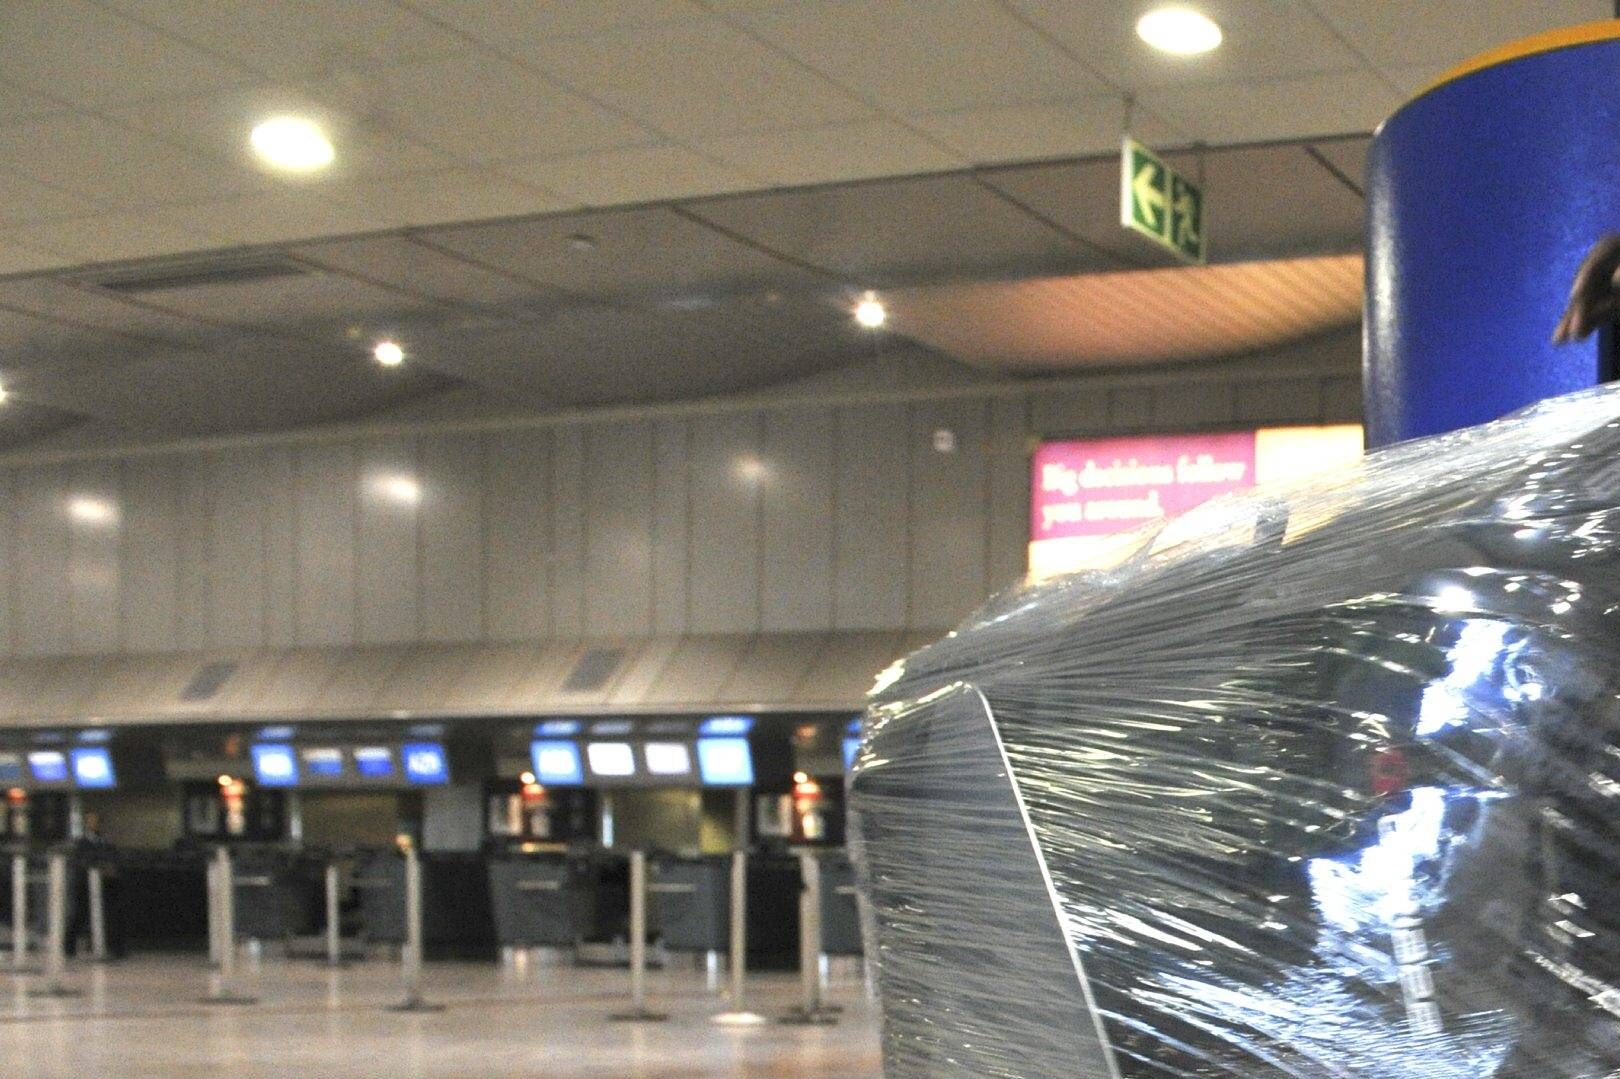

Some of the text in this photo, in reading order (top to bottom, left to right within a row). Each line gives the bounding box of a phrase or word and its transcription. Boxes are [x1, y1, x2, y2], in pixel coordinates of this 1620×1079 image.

[1042, 454, 1246, 496] Big decisions follow
[1042, 502, 1082, 530] you
